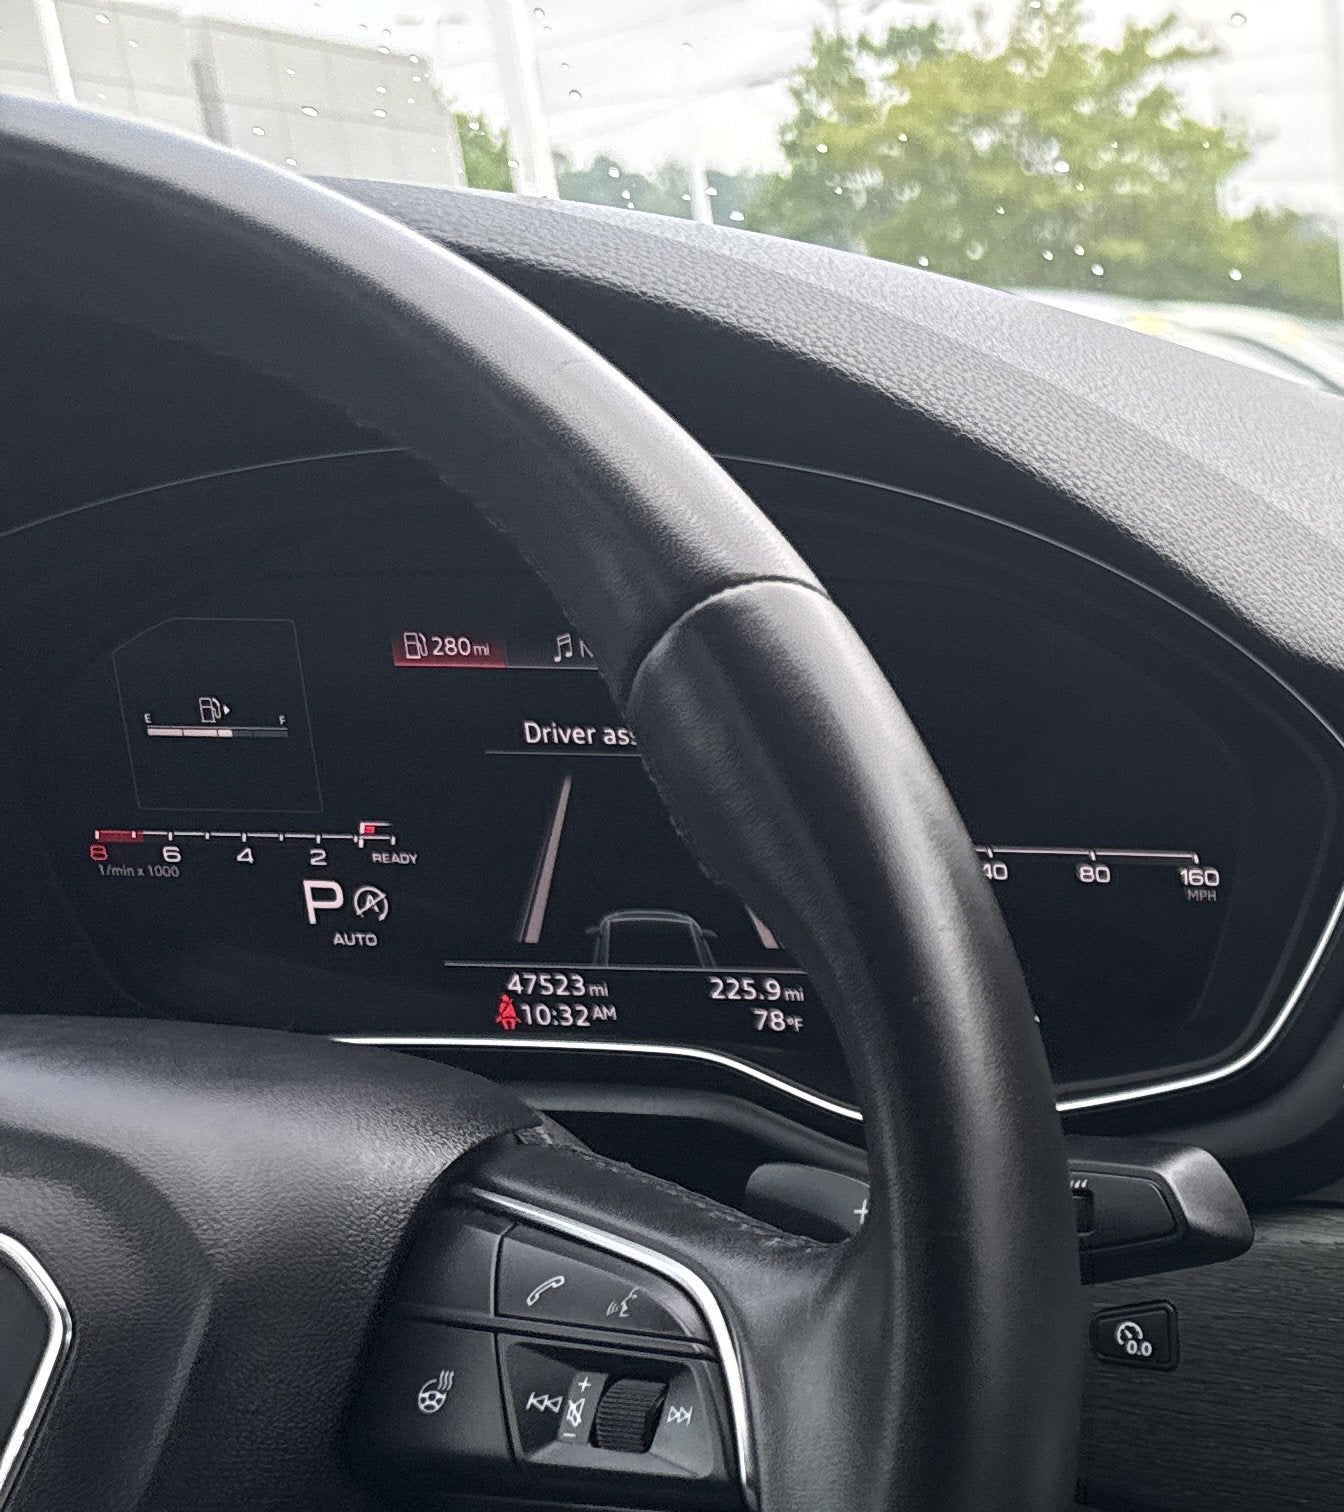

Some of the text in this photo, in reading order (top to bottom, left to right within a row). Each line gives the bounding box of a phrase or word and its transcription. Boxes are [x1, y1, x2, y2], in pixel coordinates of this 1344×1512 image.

[522, 719, 597, 745] Driver
[162, 845, 182, 863] 6
[236, 847, 255, 864] 4
[309, 848, 328, 866] 2
[371, 850, 419, 865] READY
[148, 865, 181, 878] 1000
[1076, 862, 1111, 883] 80
[1178, 866, 1220, 887] 160
[302, 879, 345, 925] P
[1186, 888, 1217, 902] MPH
[333, 931, 379, 947] AUTO
